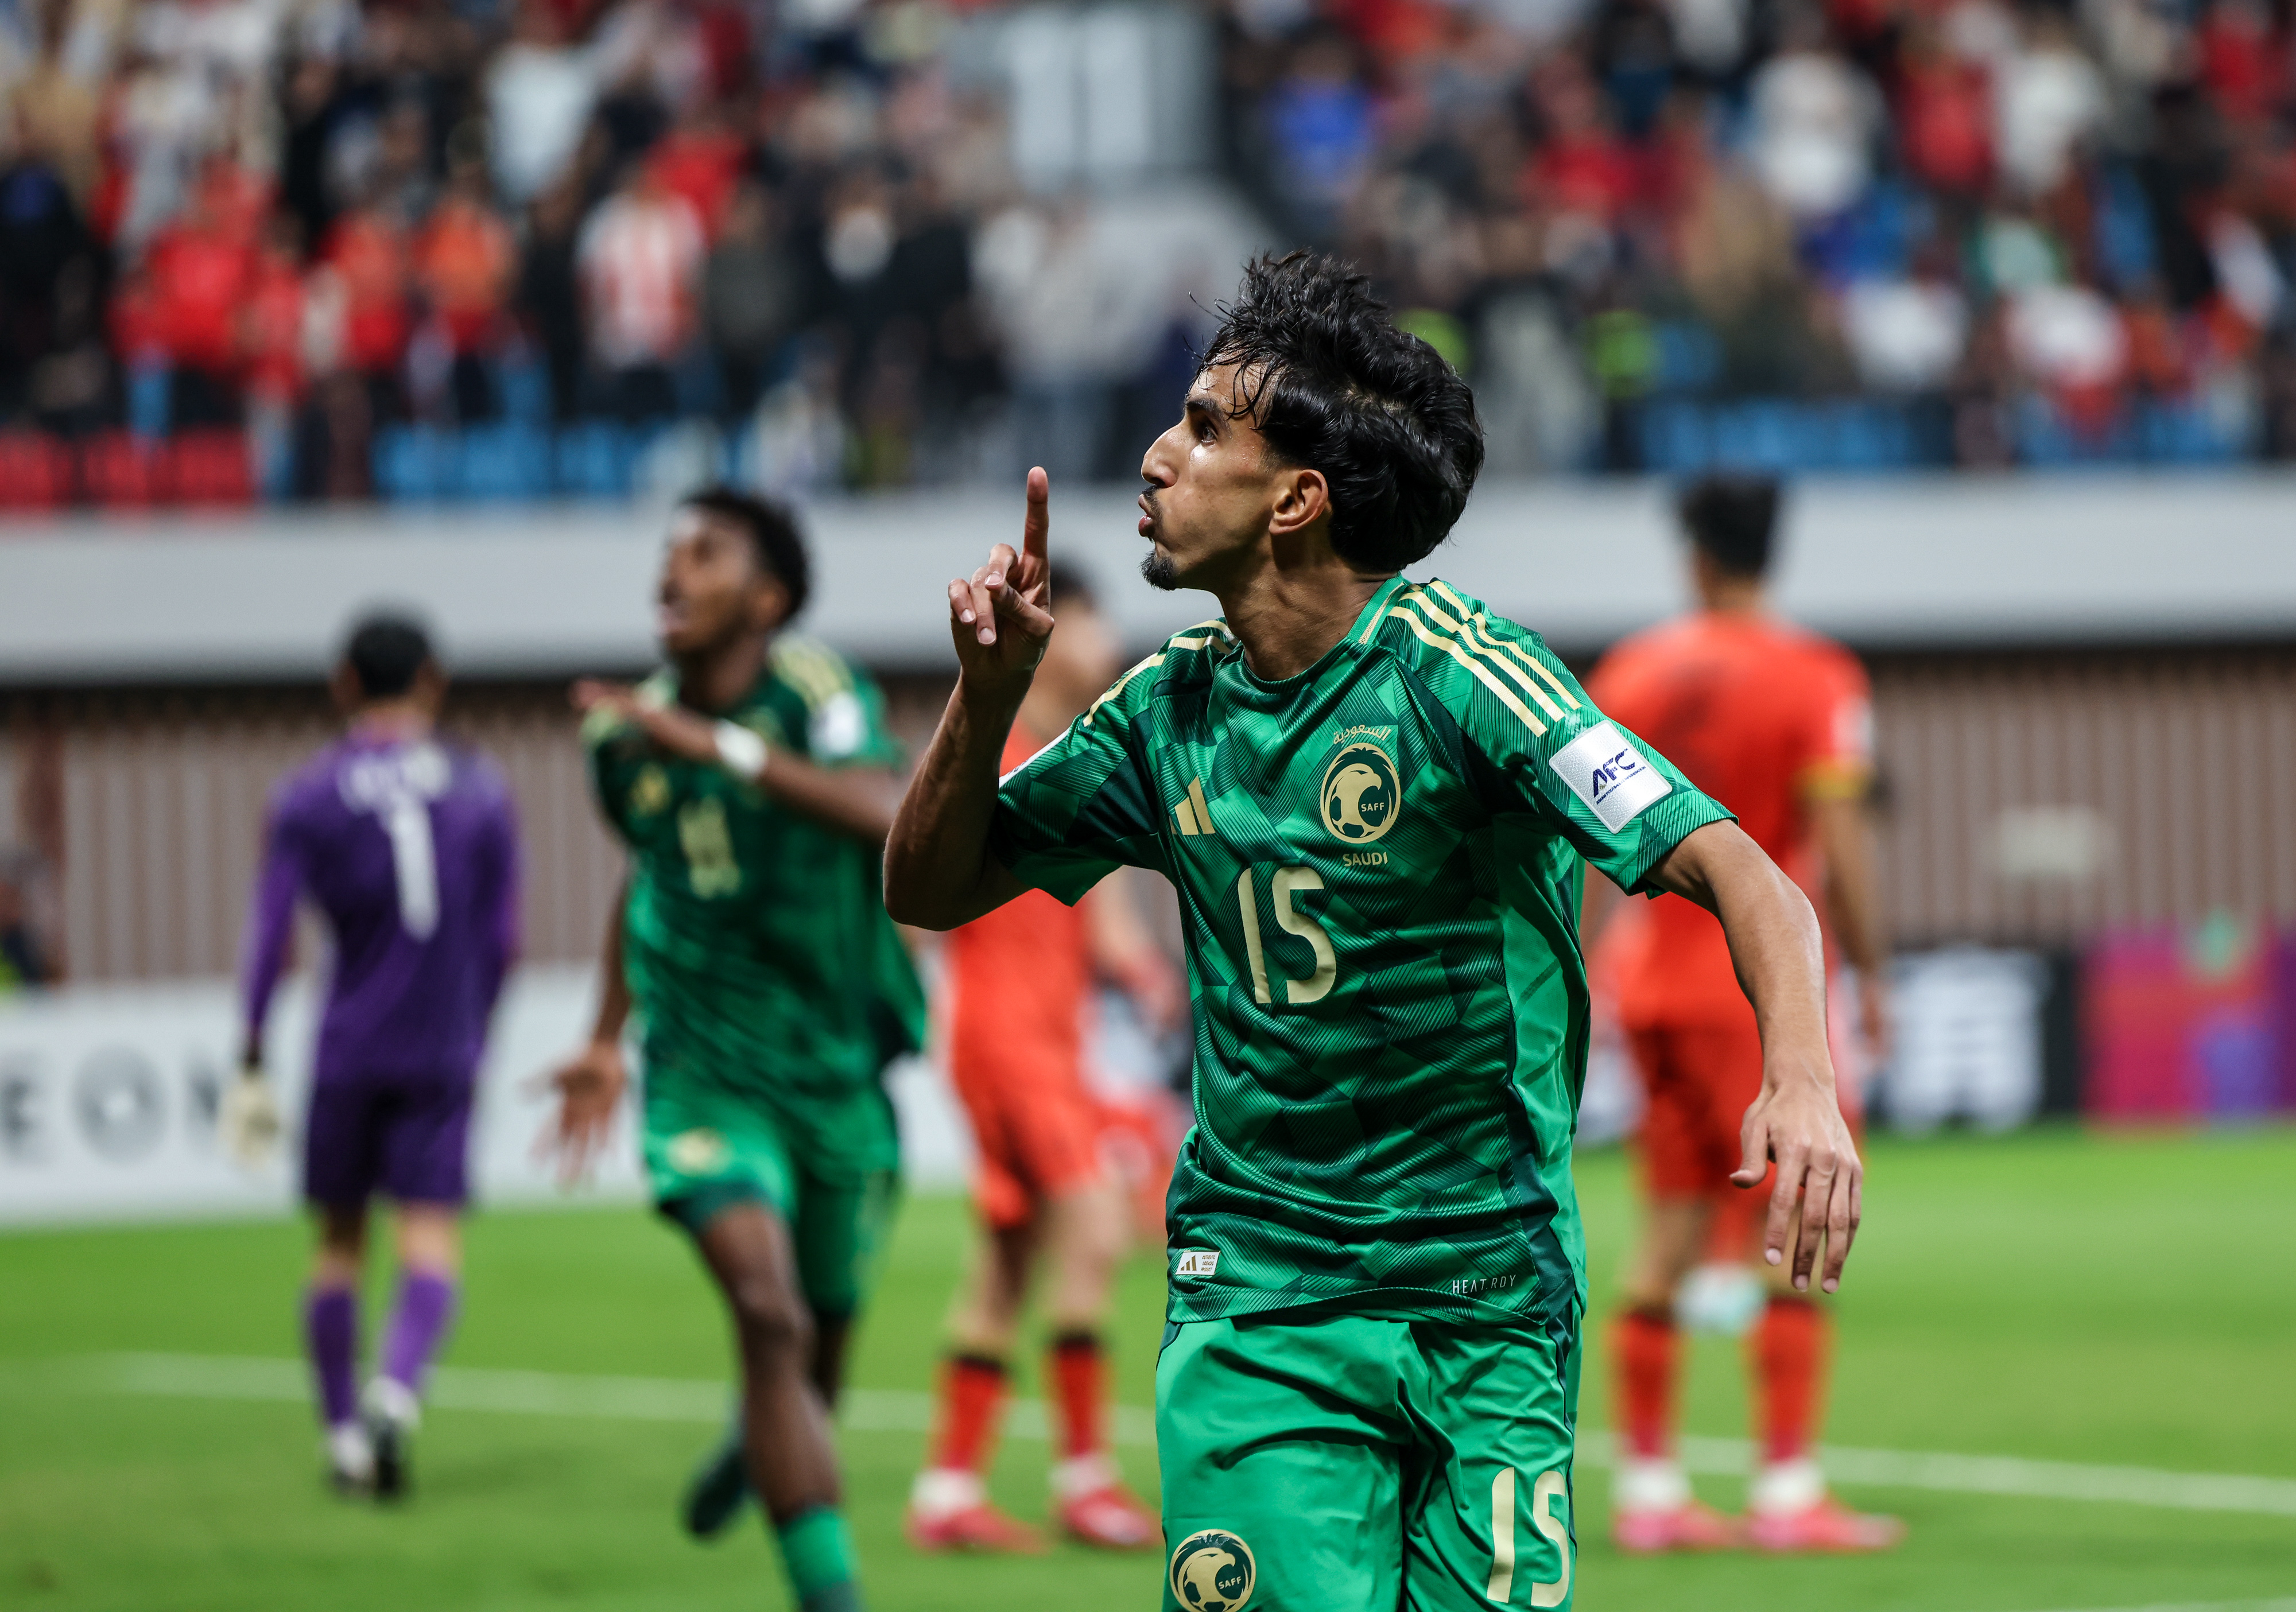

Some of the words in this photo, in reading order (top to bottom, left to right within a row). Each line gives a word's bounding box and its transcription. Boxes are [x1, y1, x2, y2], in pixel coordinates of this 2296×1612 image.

[1333, 724, 1391, 744] السعودية
[1593, 750, 1635, 798] AFC
[1361, 802, 1384, 812] SAFF
[1342, 852, 1388, 867] SAUDI
[1238, 866, 1336, 1004] 15
[1452, 1274, 1516, 1294] HEAT.RDY
[1487, 1466, 1570, 1608] 15
[1218, 1576, 1242, 1590] SAFF
